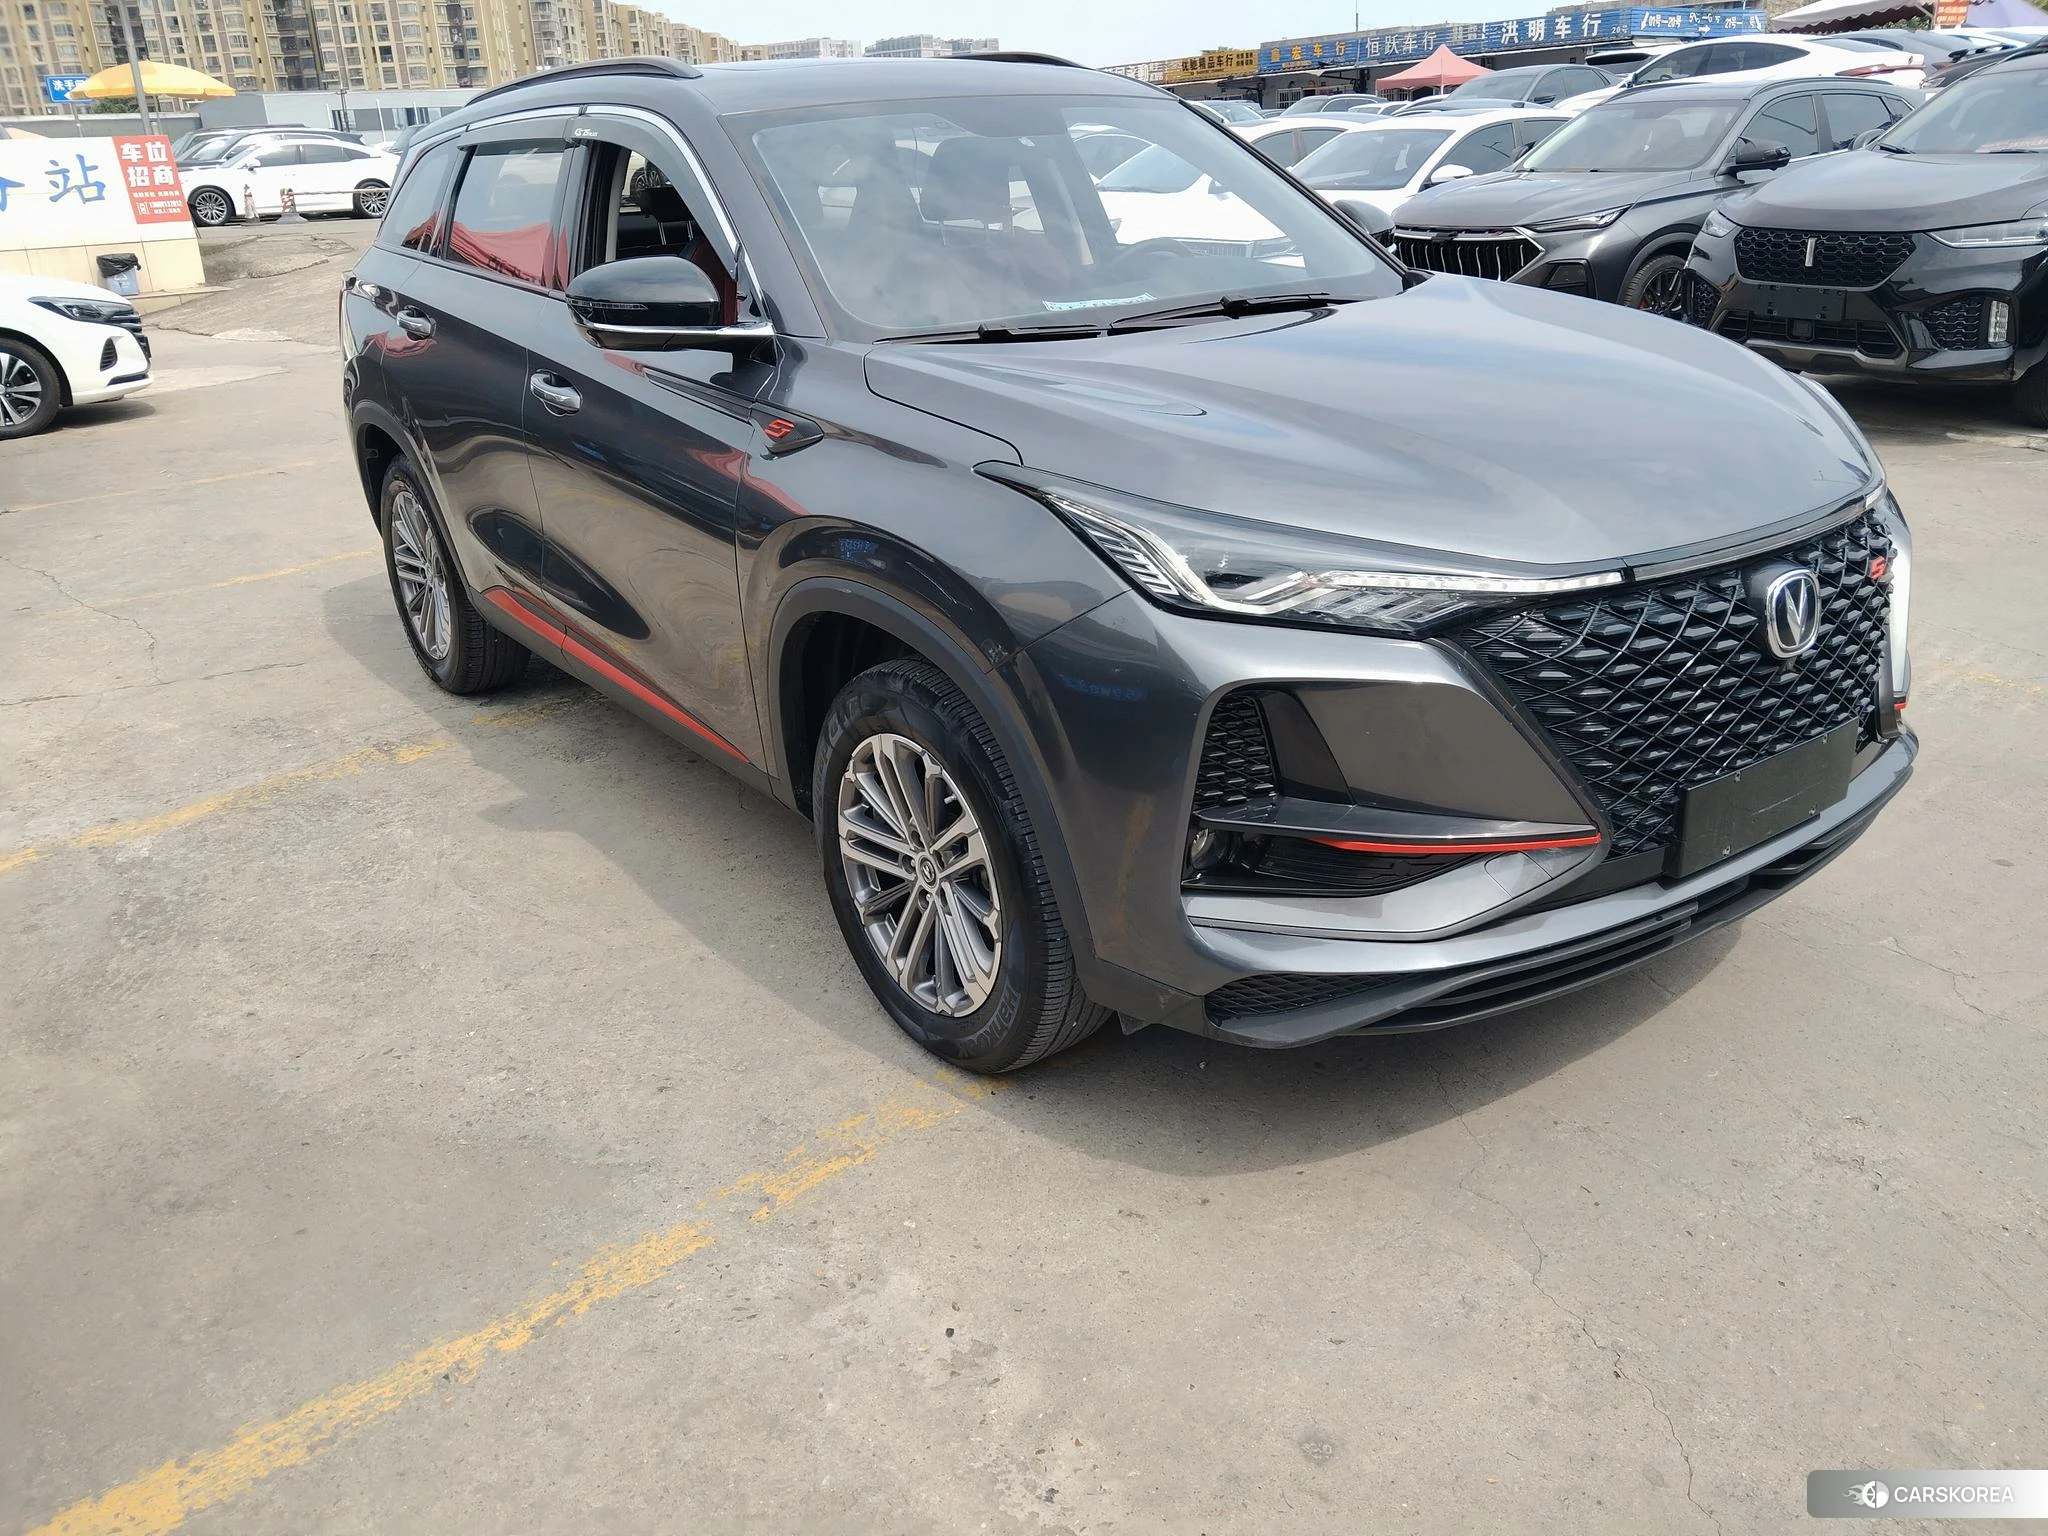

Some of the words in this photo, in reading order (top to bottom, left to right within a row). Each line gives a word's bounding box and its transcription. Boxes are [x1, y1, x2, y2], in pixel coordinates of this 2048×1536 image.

[1501, 13, 1601, 45] 洪明车行
[120, 142, 168, 162] 车位
[127, 165, 174, 187] 招商
